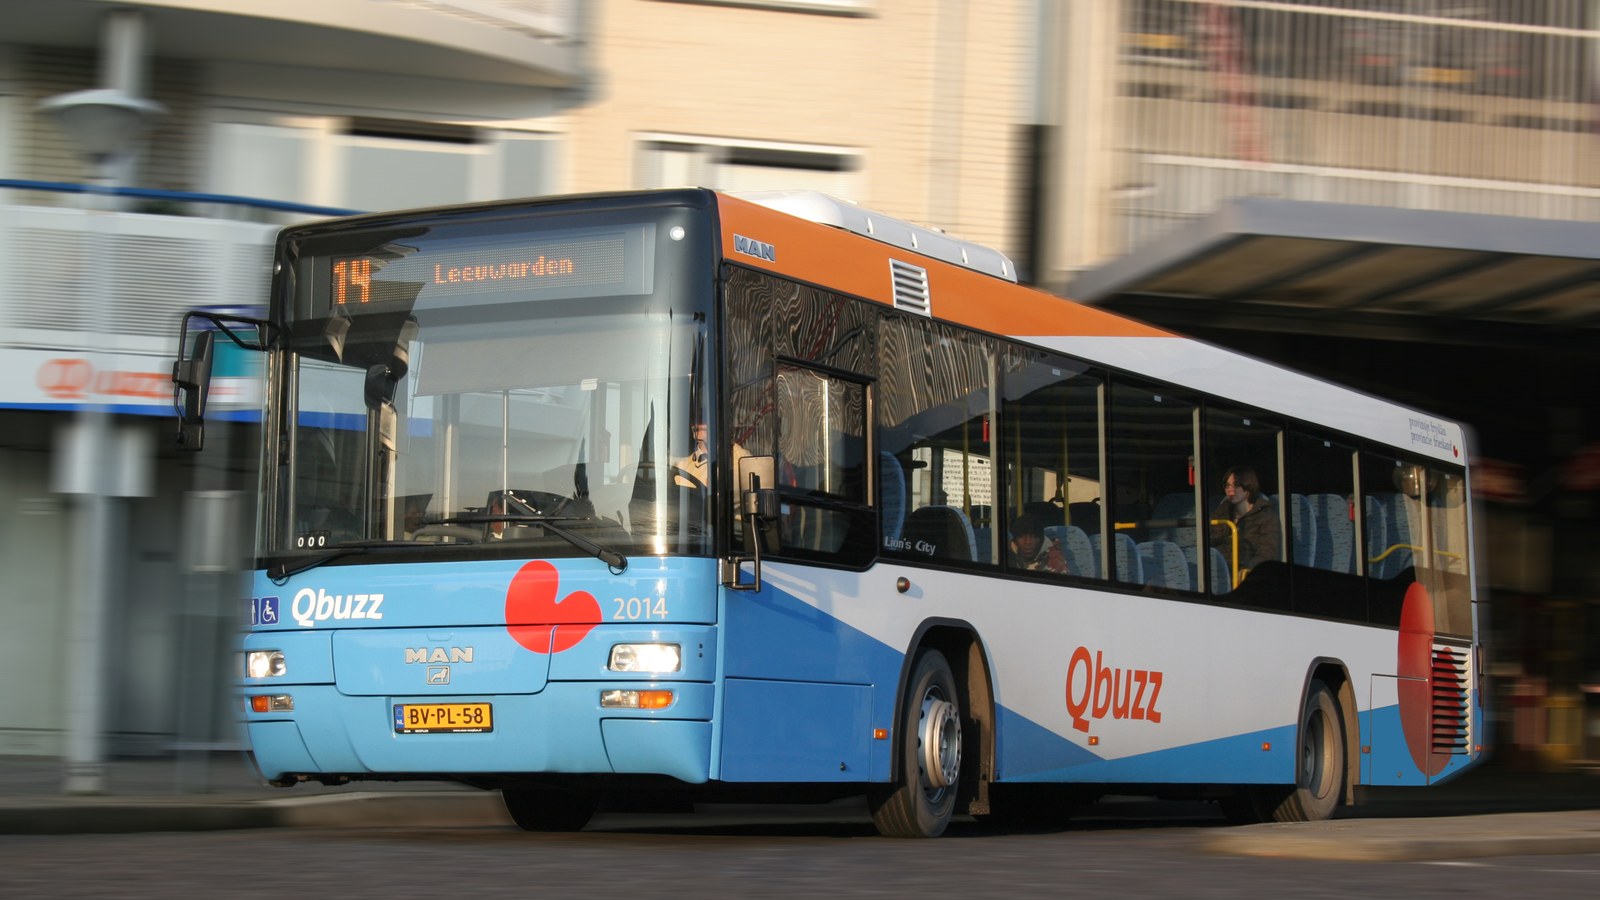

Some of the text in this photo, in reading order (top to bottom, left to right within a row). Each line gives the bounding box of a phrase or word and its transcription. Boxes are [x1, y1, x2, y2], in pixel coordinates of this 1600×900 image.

[733, 233, 776, 263] MAN
[334, 256, 574, 304] 14 Leeuwarden
[884, 536, 937, 556] Lion's City
[291, 587, 384, 627] Qbuzz
[612, 597, 669, 620] 2014
[404, 647, 474, 664] MAN
[1065, 646, 1163, 733] Qbuzz
[409, 707, 484, 725] BV-PL-58
